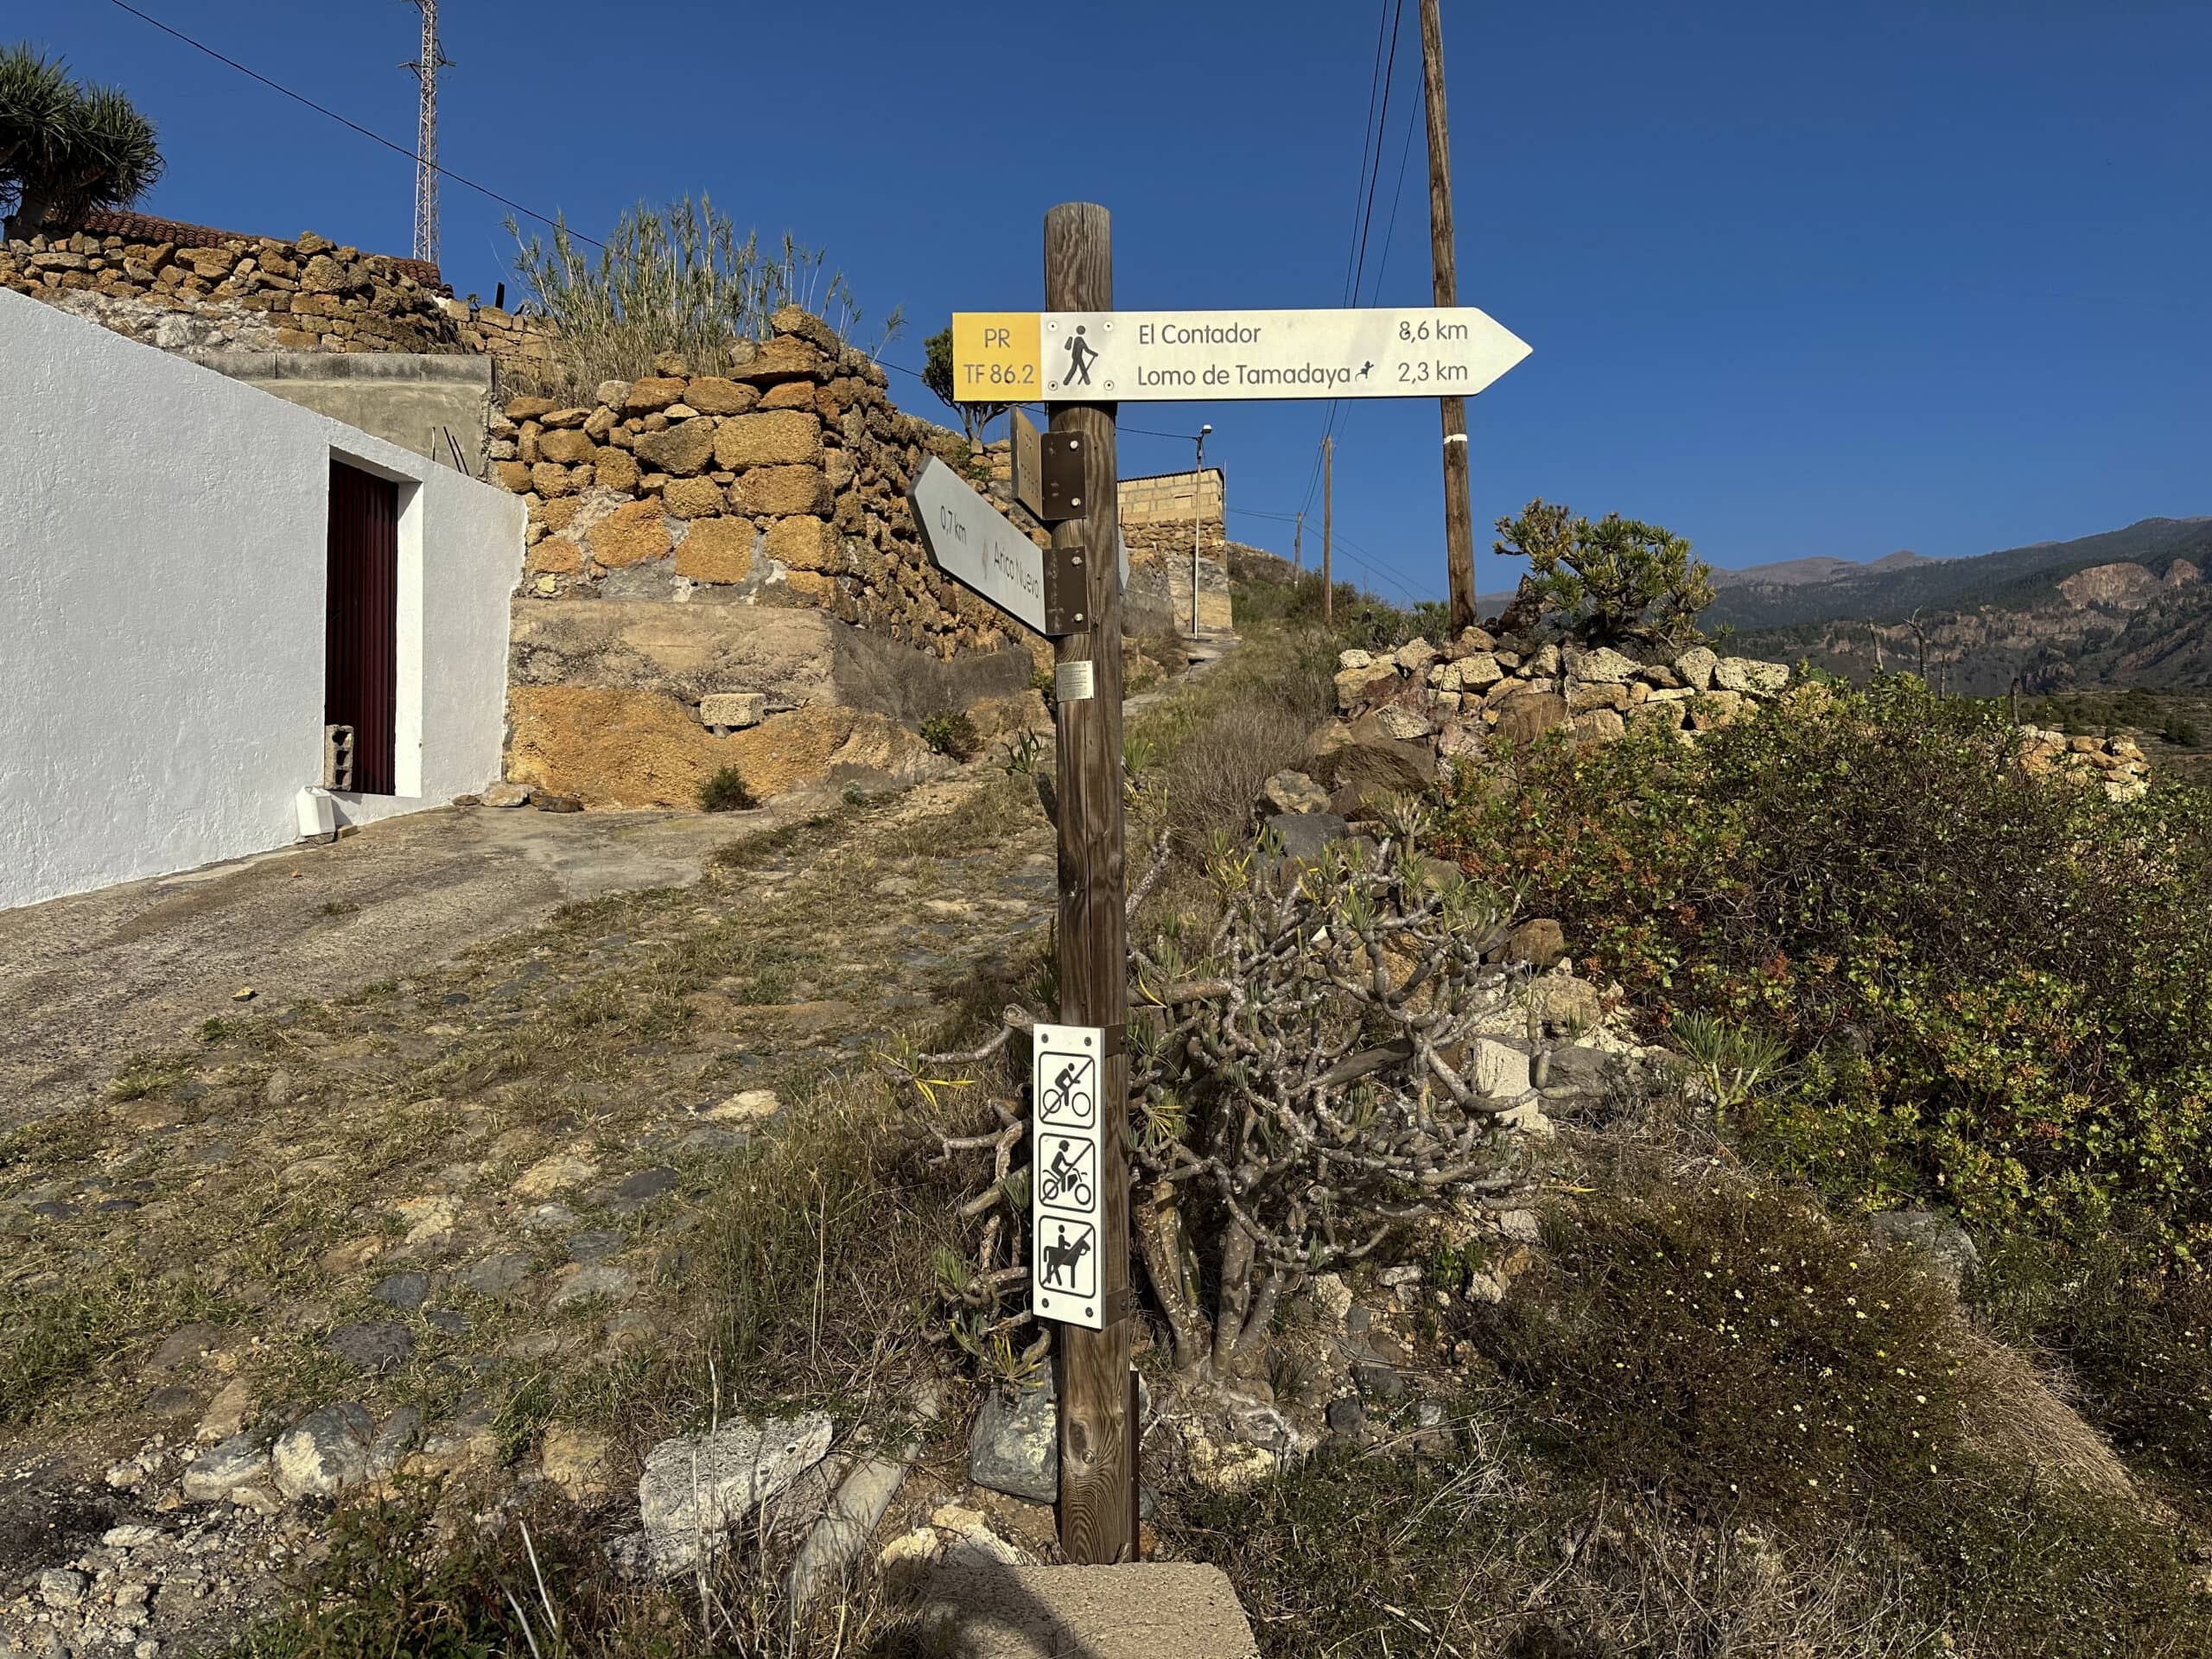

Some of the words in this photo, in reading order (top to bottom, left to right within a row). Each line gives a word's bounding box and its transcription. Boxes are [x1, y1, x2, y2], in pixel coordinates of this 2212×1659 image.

[984, 328, 1010, 348] PR
[1139, 323, 1154, 344] El
[1161, 322, 1262, 344] Contador
[1399, 321, 1430, 343] 8,6
[1436, 319, 1468, 340] km
[963, 364, 985, 384] TF
[990, 364, 1034, 384] 86.2
[1137, 365, 1196, 385] Lomo
[1202, 364, 1230, 385] de
[1235, 362, 1351, 389] Tamadaya
[1398, 361, 1430, 385] 2,3
[1436, 359, 1468, 380] km
[940, 505, 953, 536] 0,7
[954, 513, 967, 546] km
[994, 540, 1014, 581] Arico
[1016, 556, 1039, 599] Nuevo
